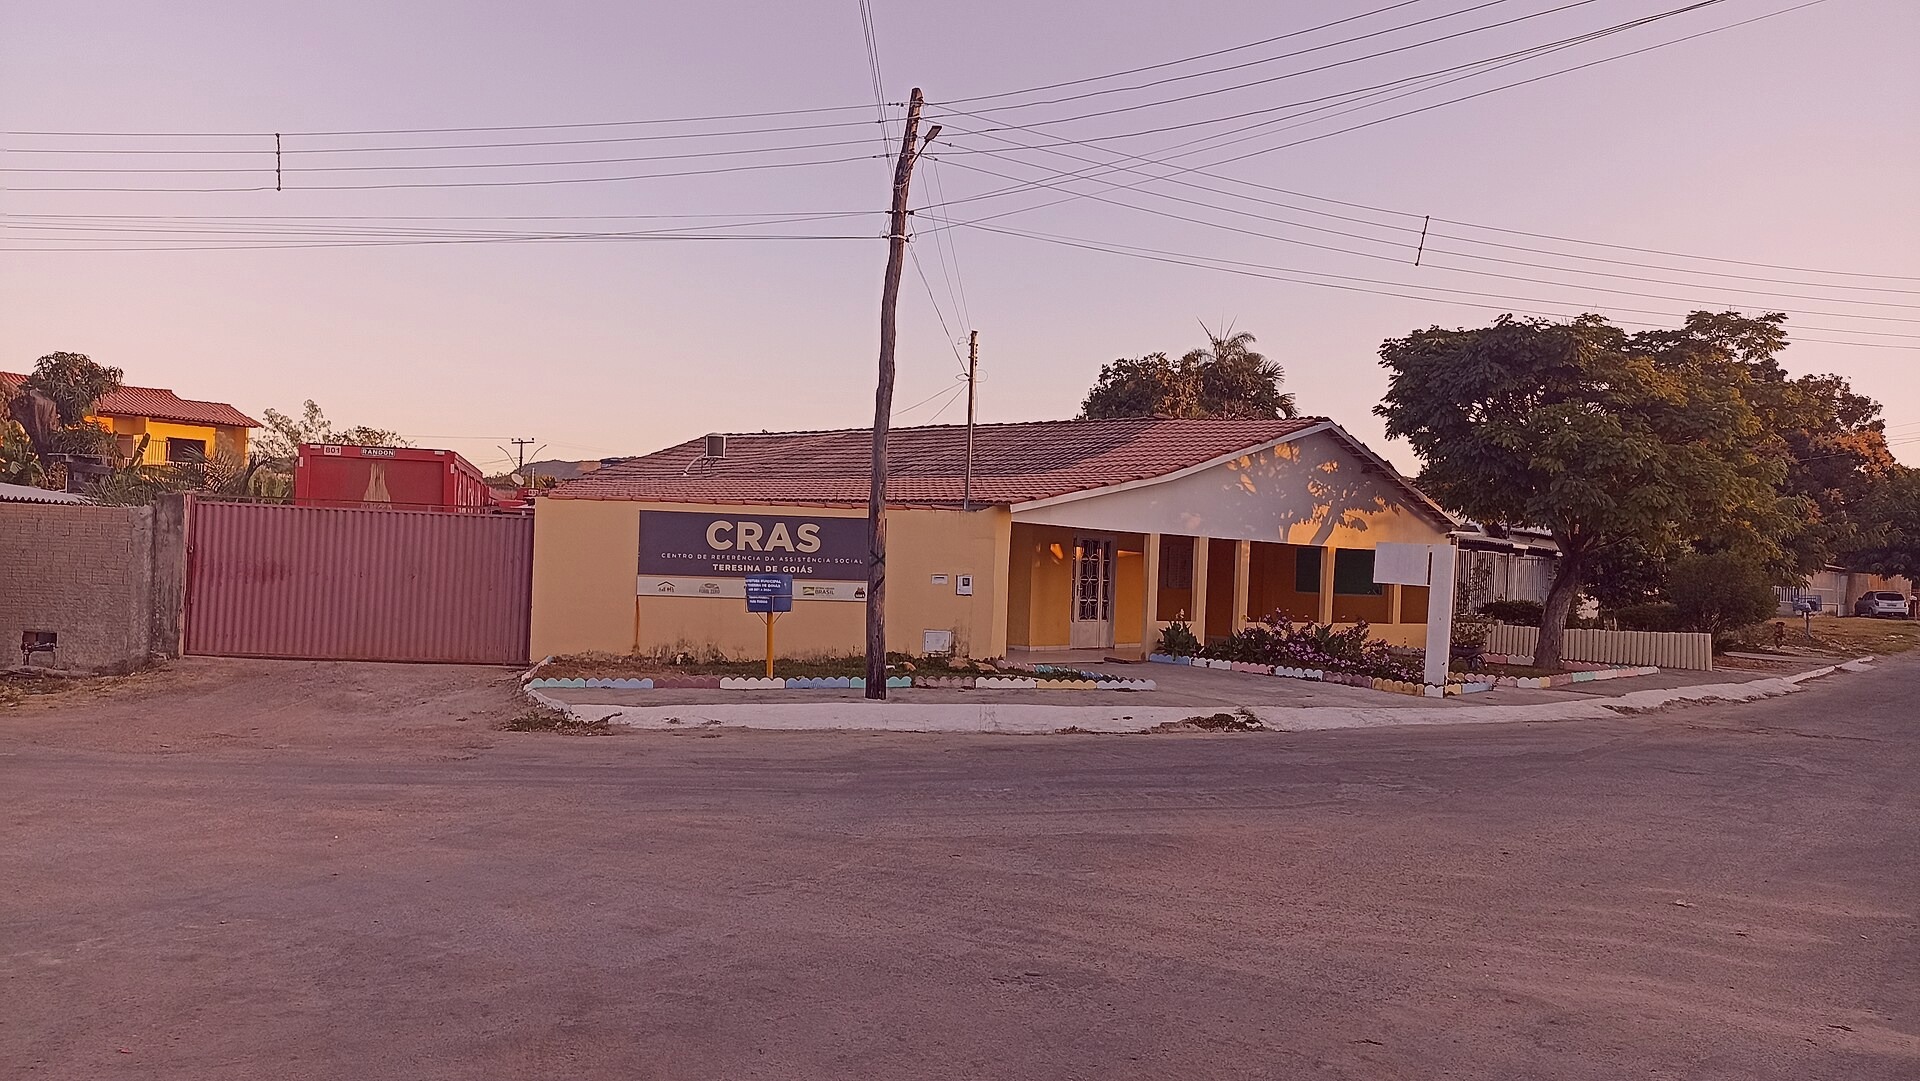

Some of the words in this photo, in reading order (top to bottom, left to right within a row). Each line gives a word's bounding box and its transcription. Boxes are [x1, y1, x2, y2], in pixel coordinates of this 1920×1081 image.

[325, 446, 340, 454] 801
[706, 520, 821, 553] CRAS
[661, 552, 694, 560] CENTRO
[711, 553, 760, 561] REFERÊNCIA
[779, 556, 831, 564] ASSISTÊNCIA
[713, 563, 760, 572] TERESINA
[765, 565, 778, 573] DE
[782, 564, 813, 574] GOIÁS
